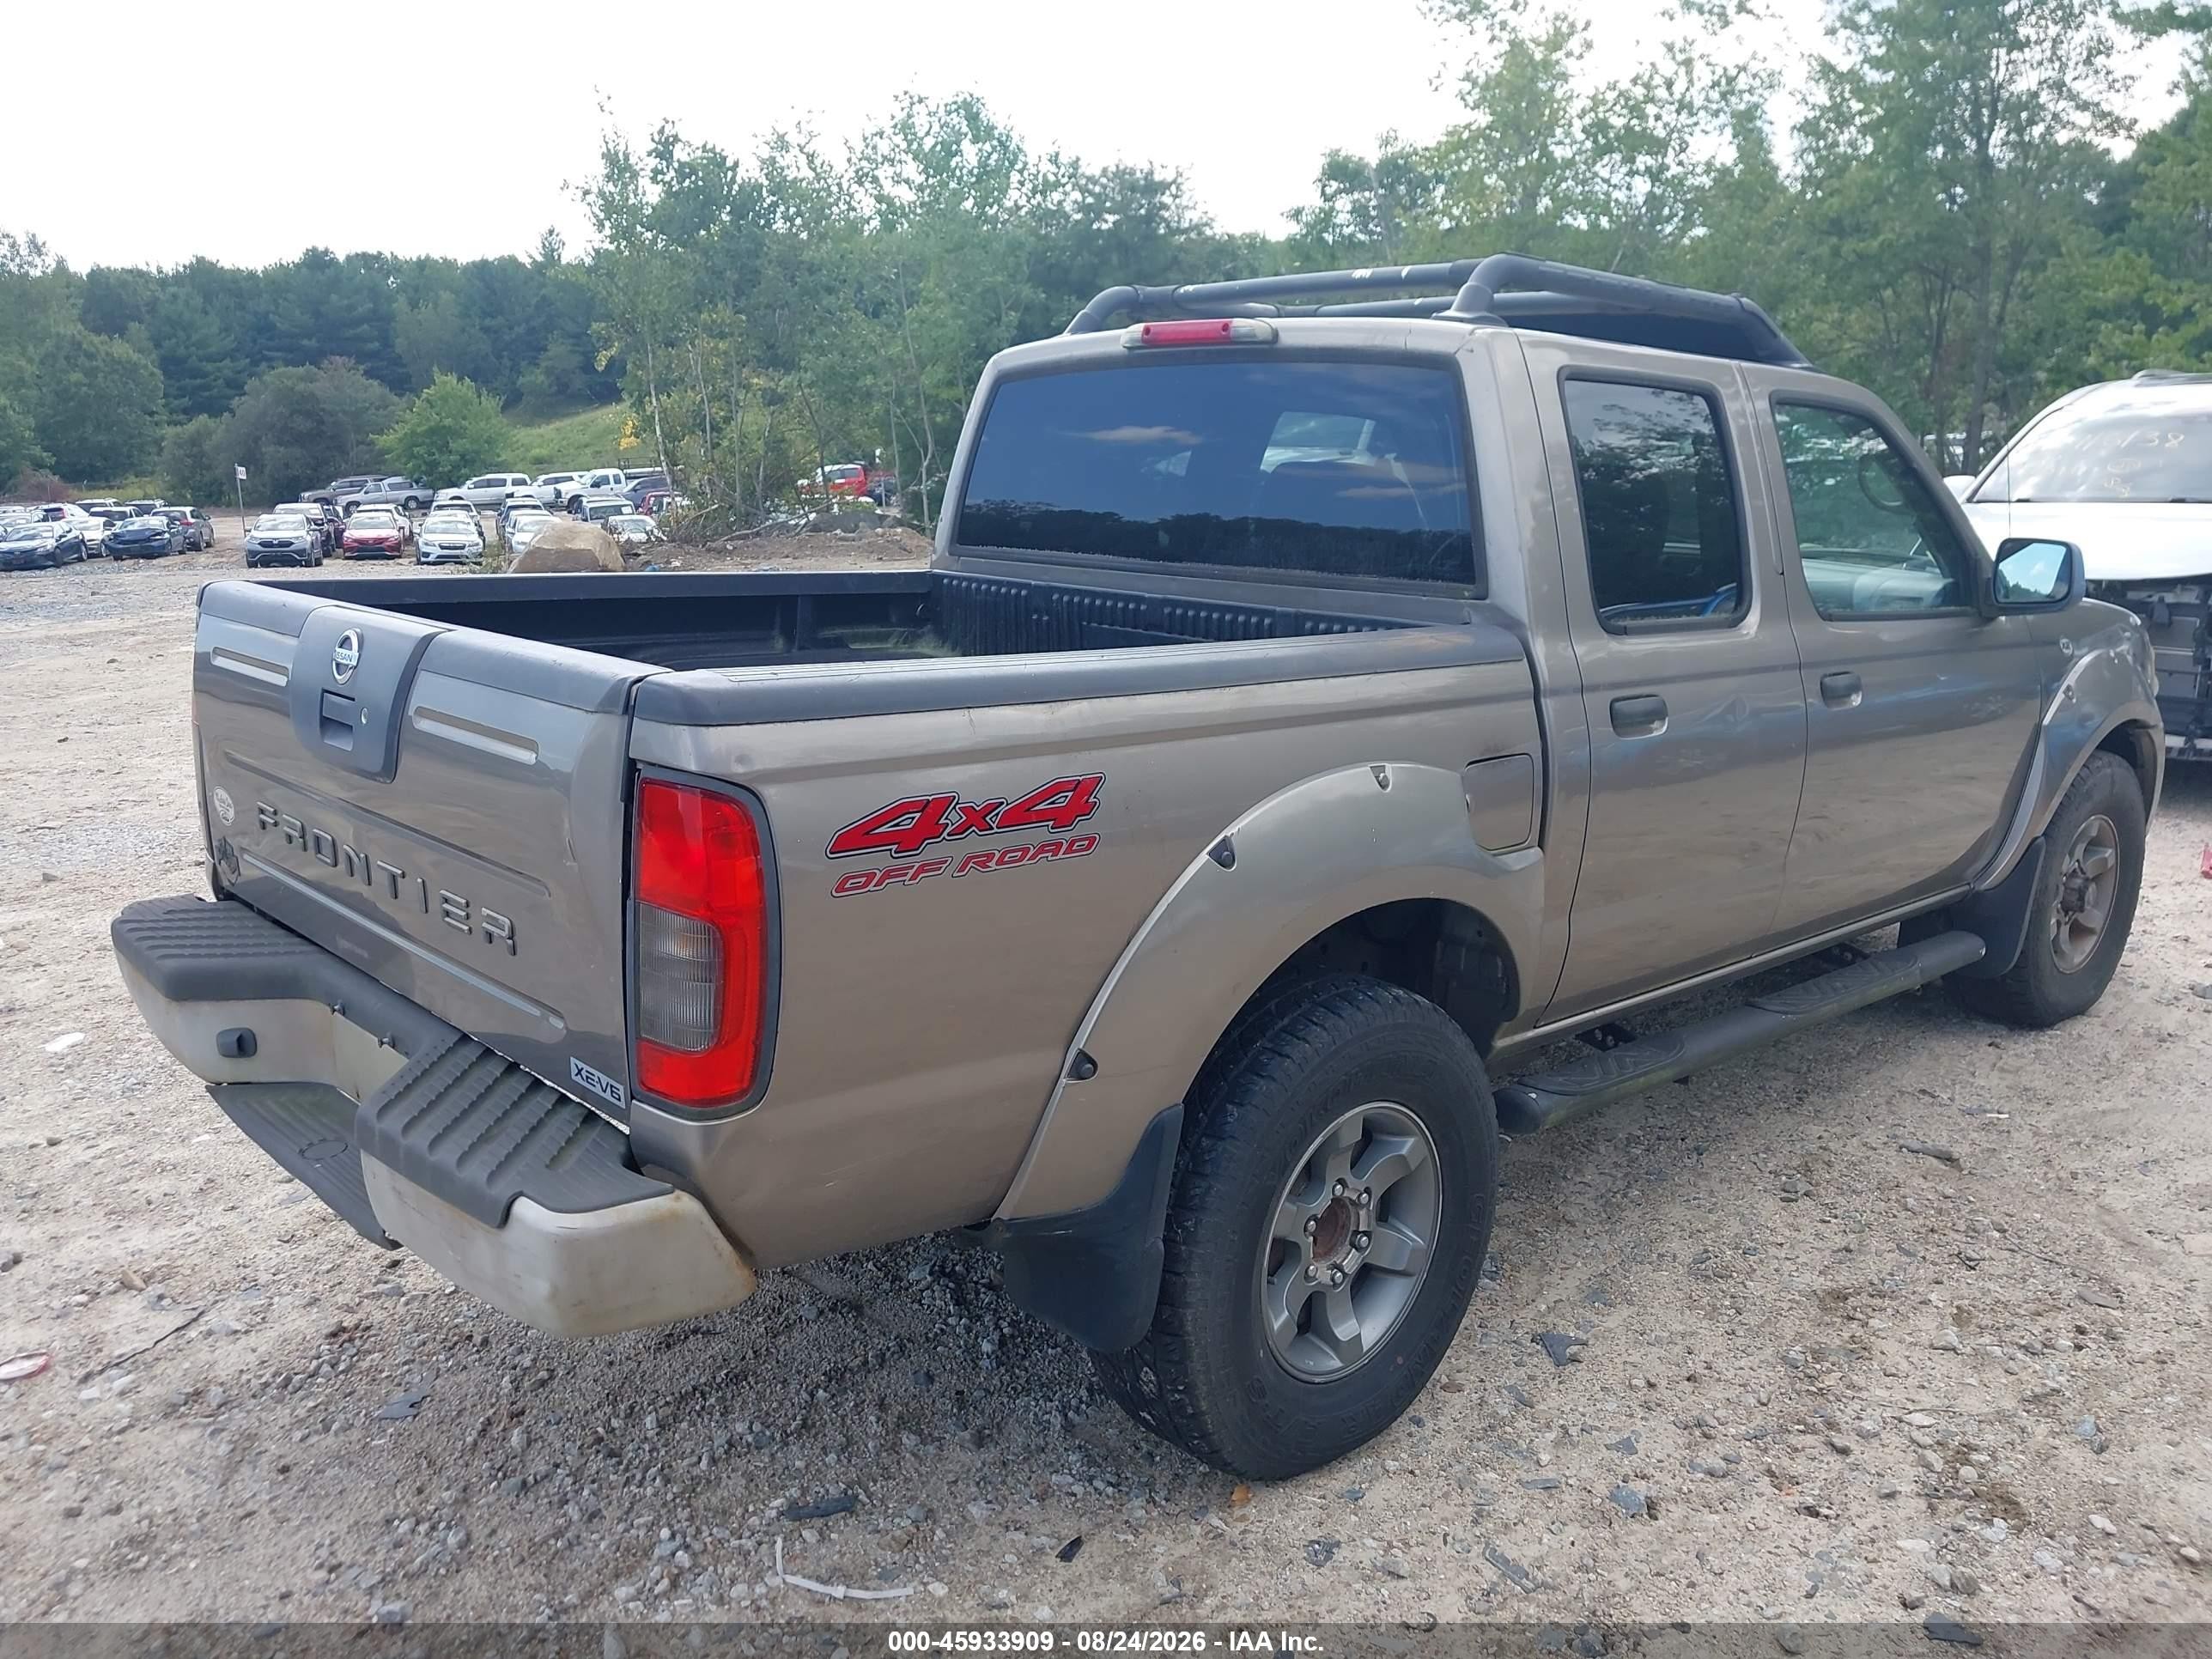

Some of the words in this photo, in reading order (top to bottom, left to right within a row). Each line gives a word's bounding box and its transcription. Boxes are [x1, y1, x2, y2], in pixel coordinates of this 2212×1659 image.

[826, 772, 1105, 859] 4x4
[257, 800, 516, 956] FRONTIER
[831, 857, 954, 898] OFF
[951, 833, 1102, 878] ROAD
